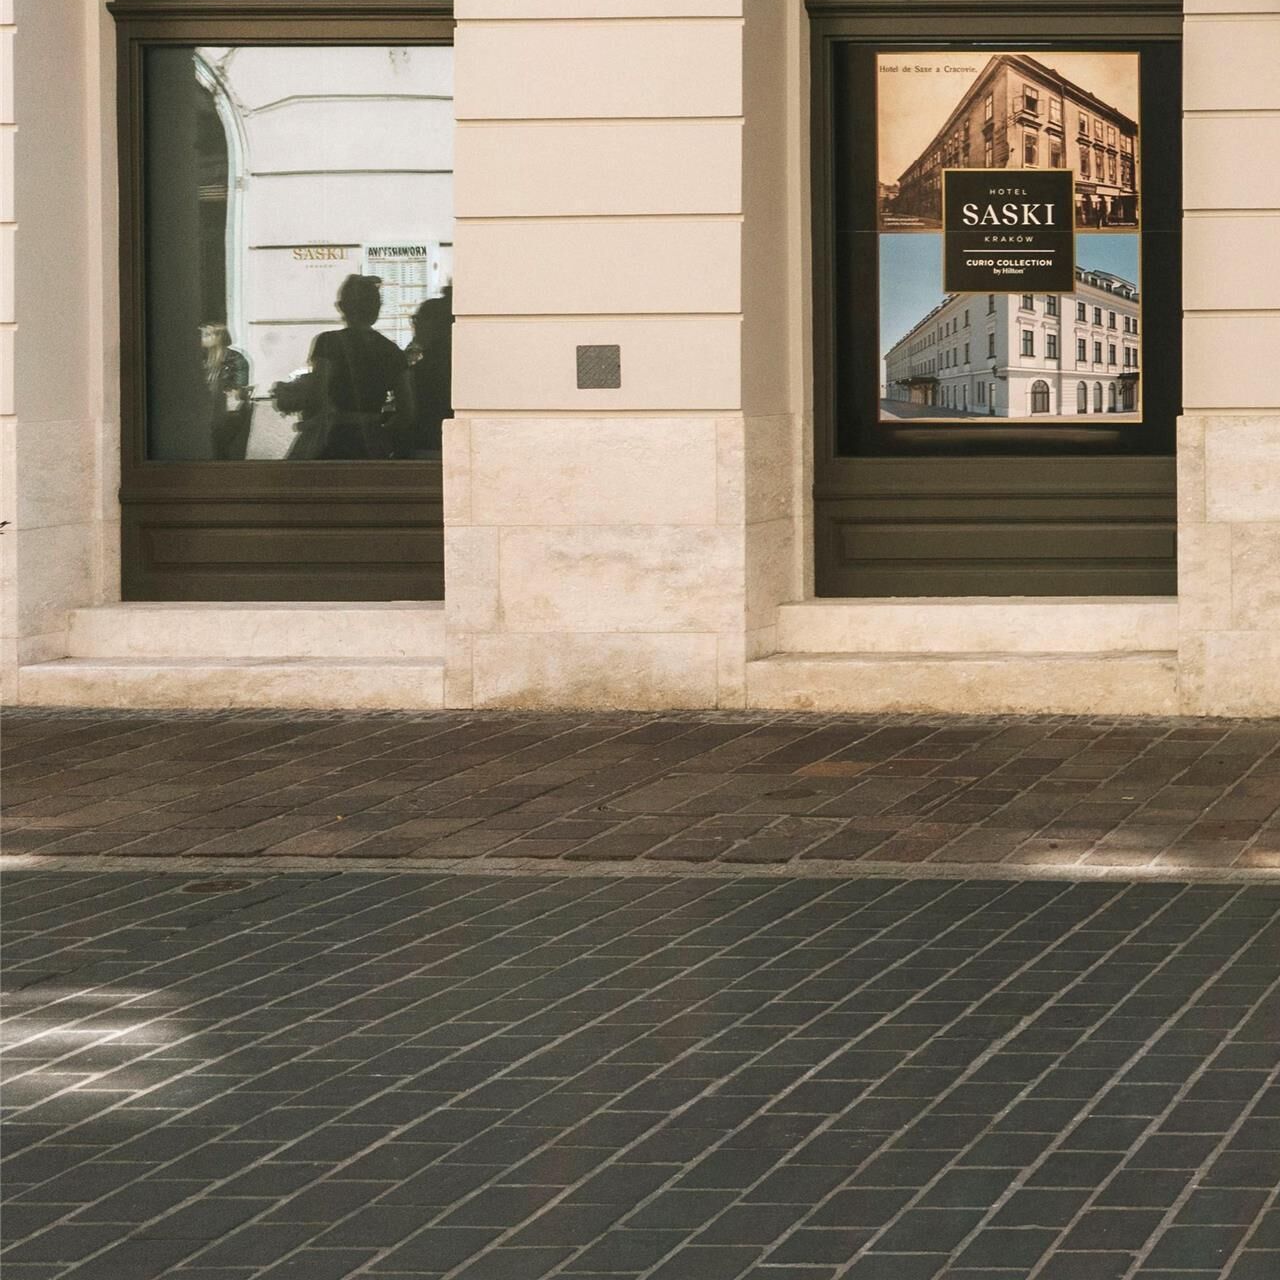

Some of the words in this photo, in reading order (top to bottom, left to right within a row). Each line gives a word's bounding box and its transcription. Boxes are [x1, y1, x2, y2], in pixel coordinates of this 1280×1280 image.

[879, 65, 899, 73] Hotel
[902, 65, 912, 73] de
[914, 65, 933, 73] Saxe
[962, 203, 1056, 226] SASKI
[984, 234, 1034, 242] KRAKÓW
[292, 247, 346, 260] SASKI
[966, 259, 995, 267] CURIO
[996, 259, 1054, 267] COLLECTION
[992, 268, 1001, 276] by
